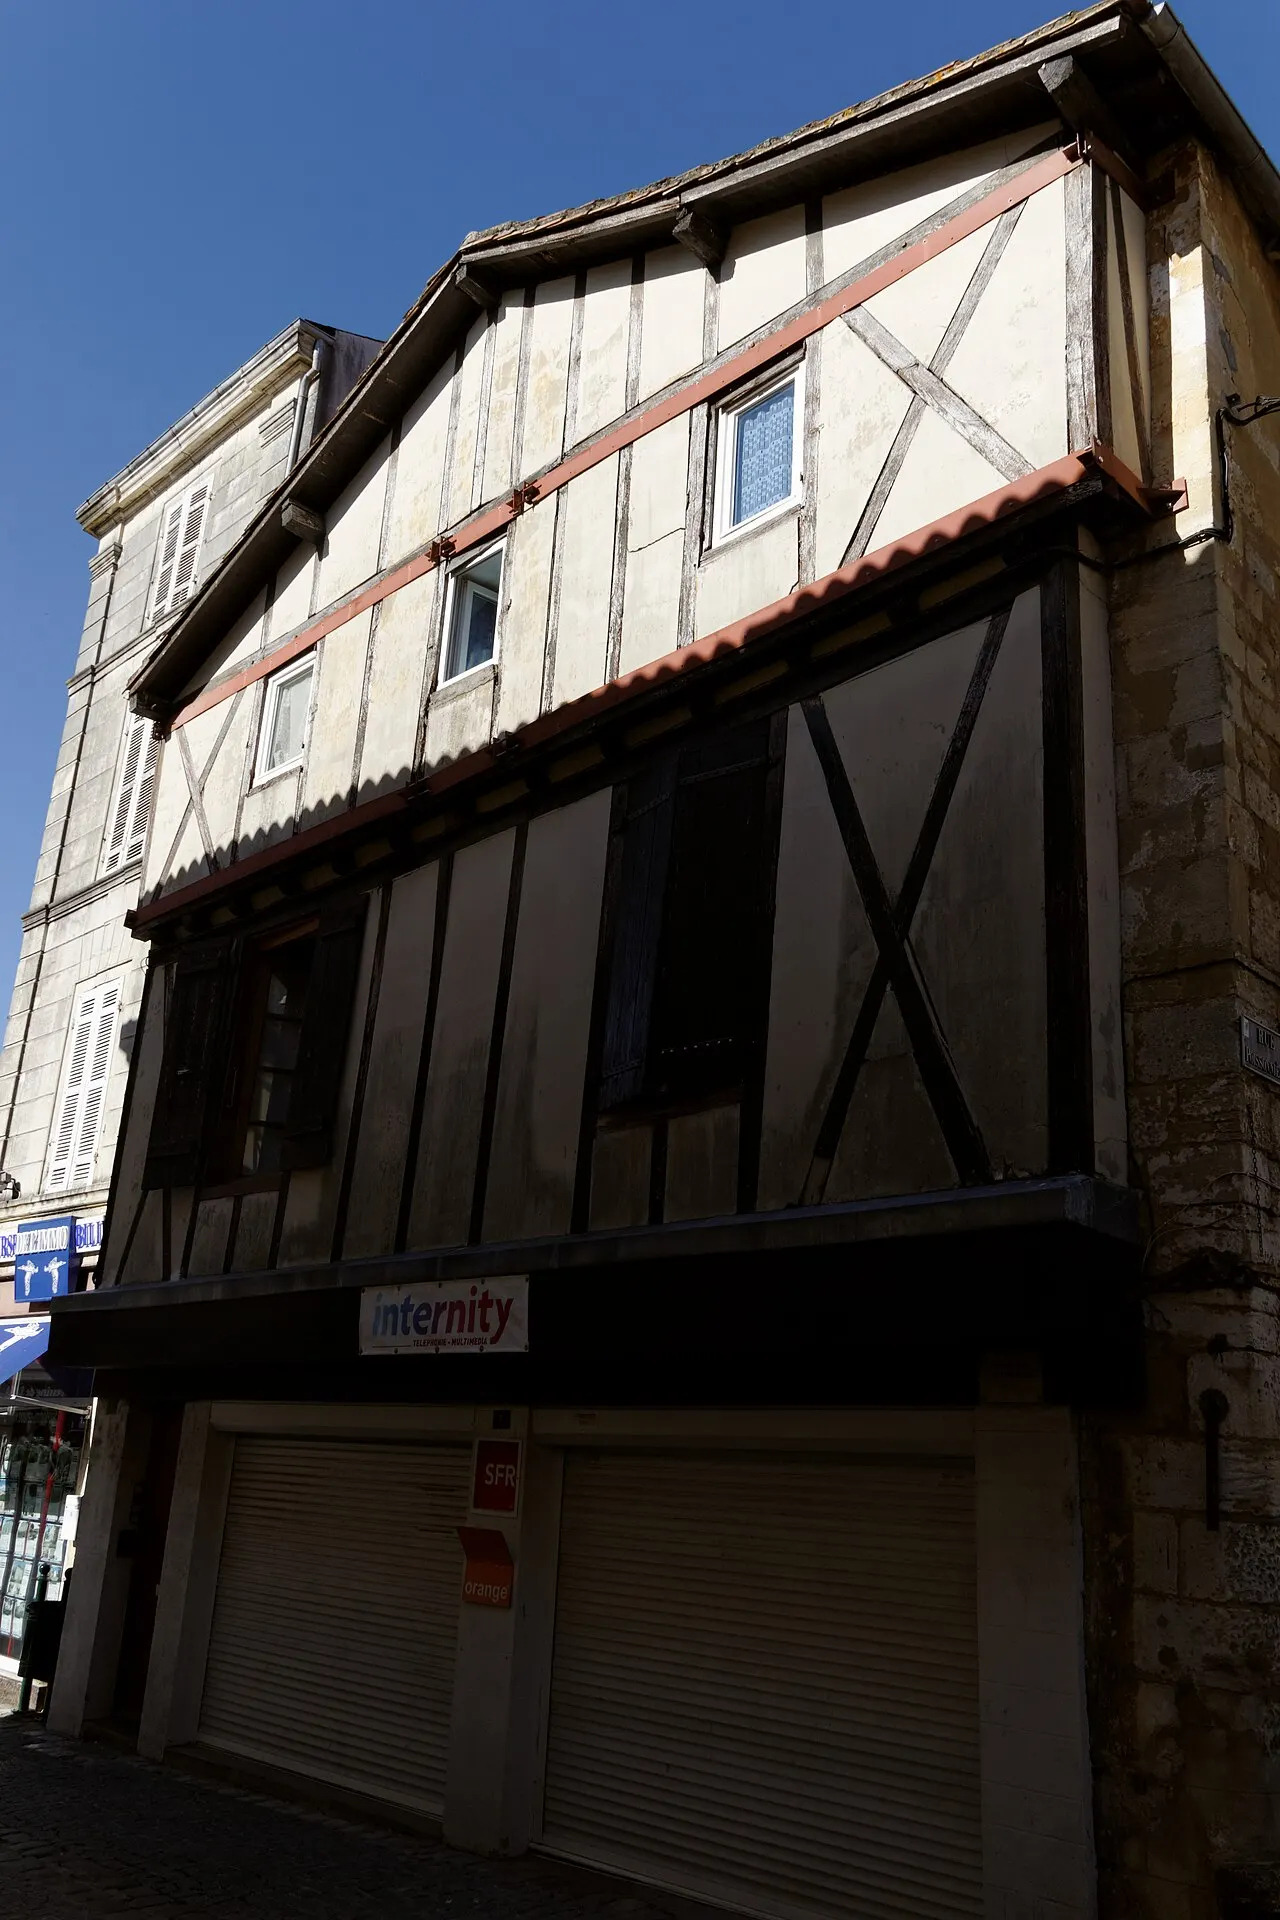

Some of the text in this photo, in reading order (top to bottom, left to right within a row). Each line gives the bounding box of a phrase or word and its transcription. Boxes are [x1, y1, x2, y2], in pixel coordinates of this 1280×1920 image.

[1257, 1026, 1275, 1050] RUE
[372, 1285, 514, 1344] internity
[484, 1462, 516, 1488] SFR
[465, 1581, 508, 1603] orange
